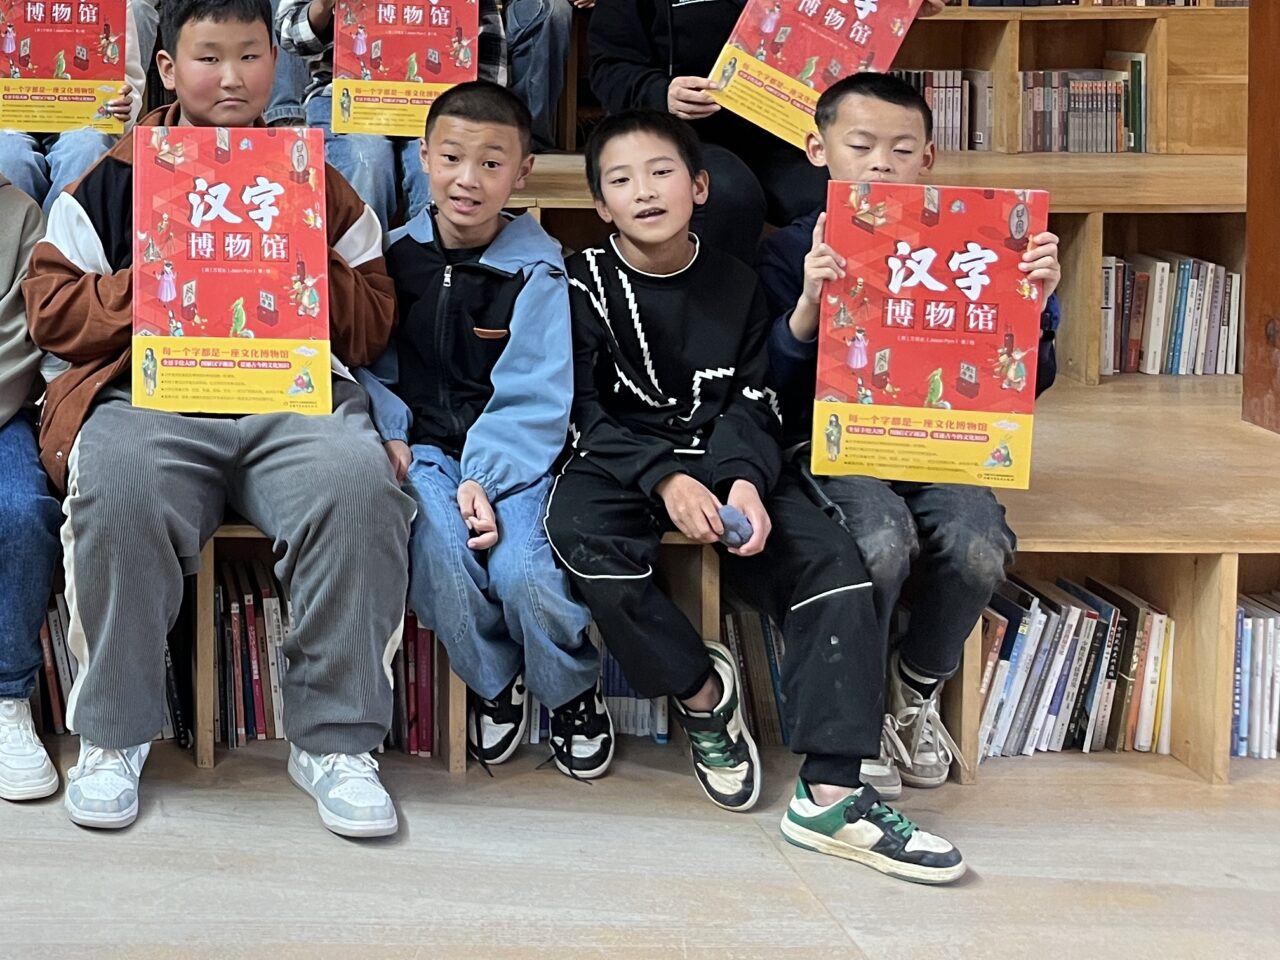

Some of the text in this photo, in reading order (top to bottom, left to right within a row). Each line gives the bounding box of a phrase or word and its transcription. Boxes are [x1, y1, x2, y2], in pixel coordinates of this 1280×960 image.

[25, 2, 99, 23] 博物馆
[376, 4, 451, 26] 博物馆
[188, 176, 285, 232] 汉字
[188, 232, 289, 261] 博物馆
[887, 241, 998, 301] 汉字
[884, 298, 999, 331] 博物馆
[162, 346, 289, 359] 每一个字都是一座文化博物馆
[848, 414, 988, 431] 每一个字都是一座文化博物馆
